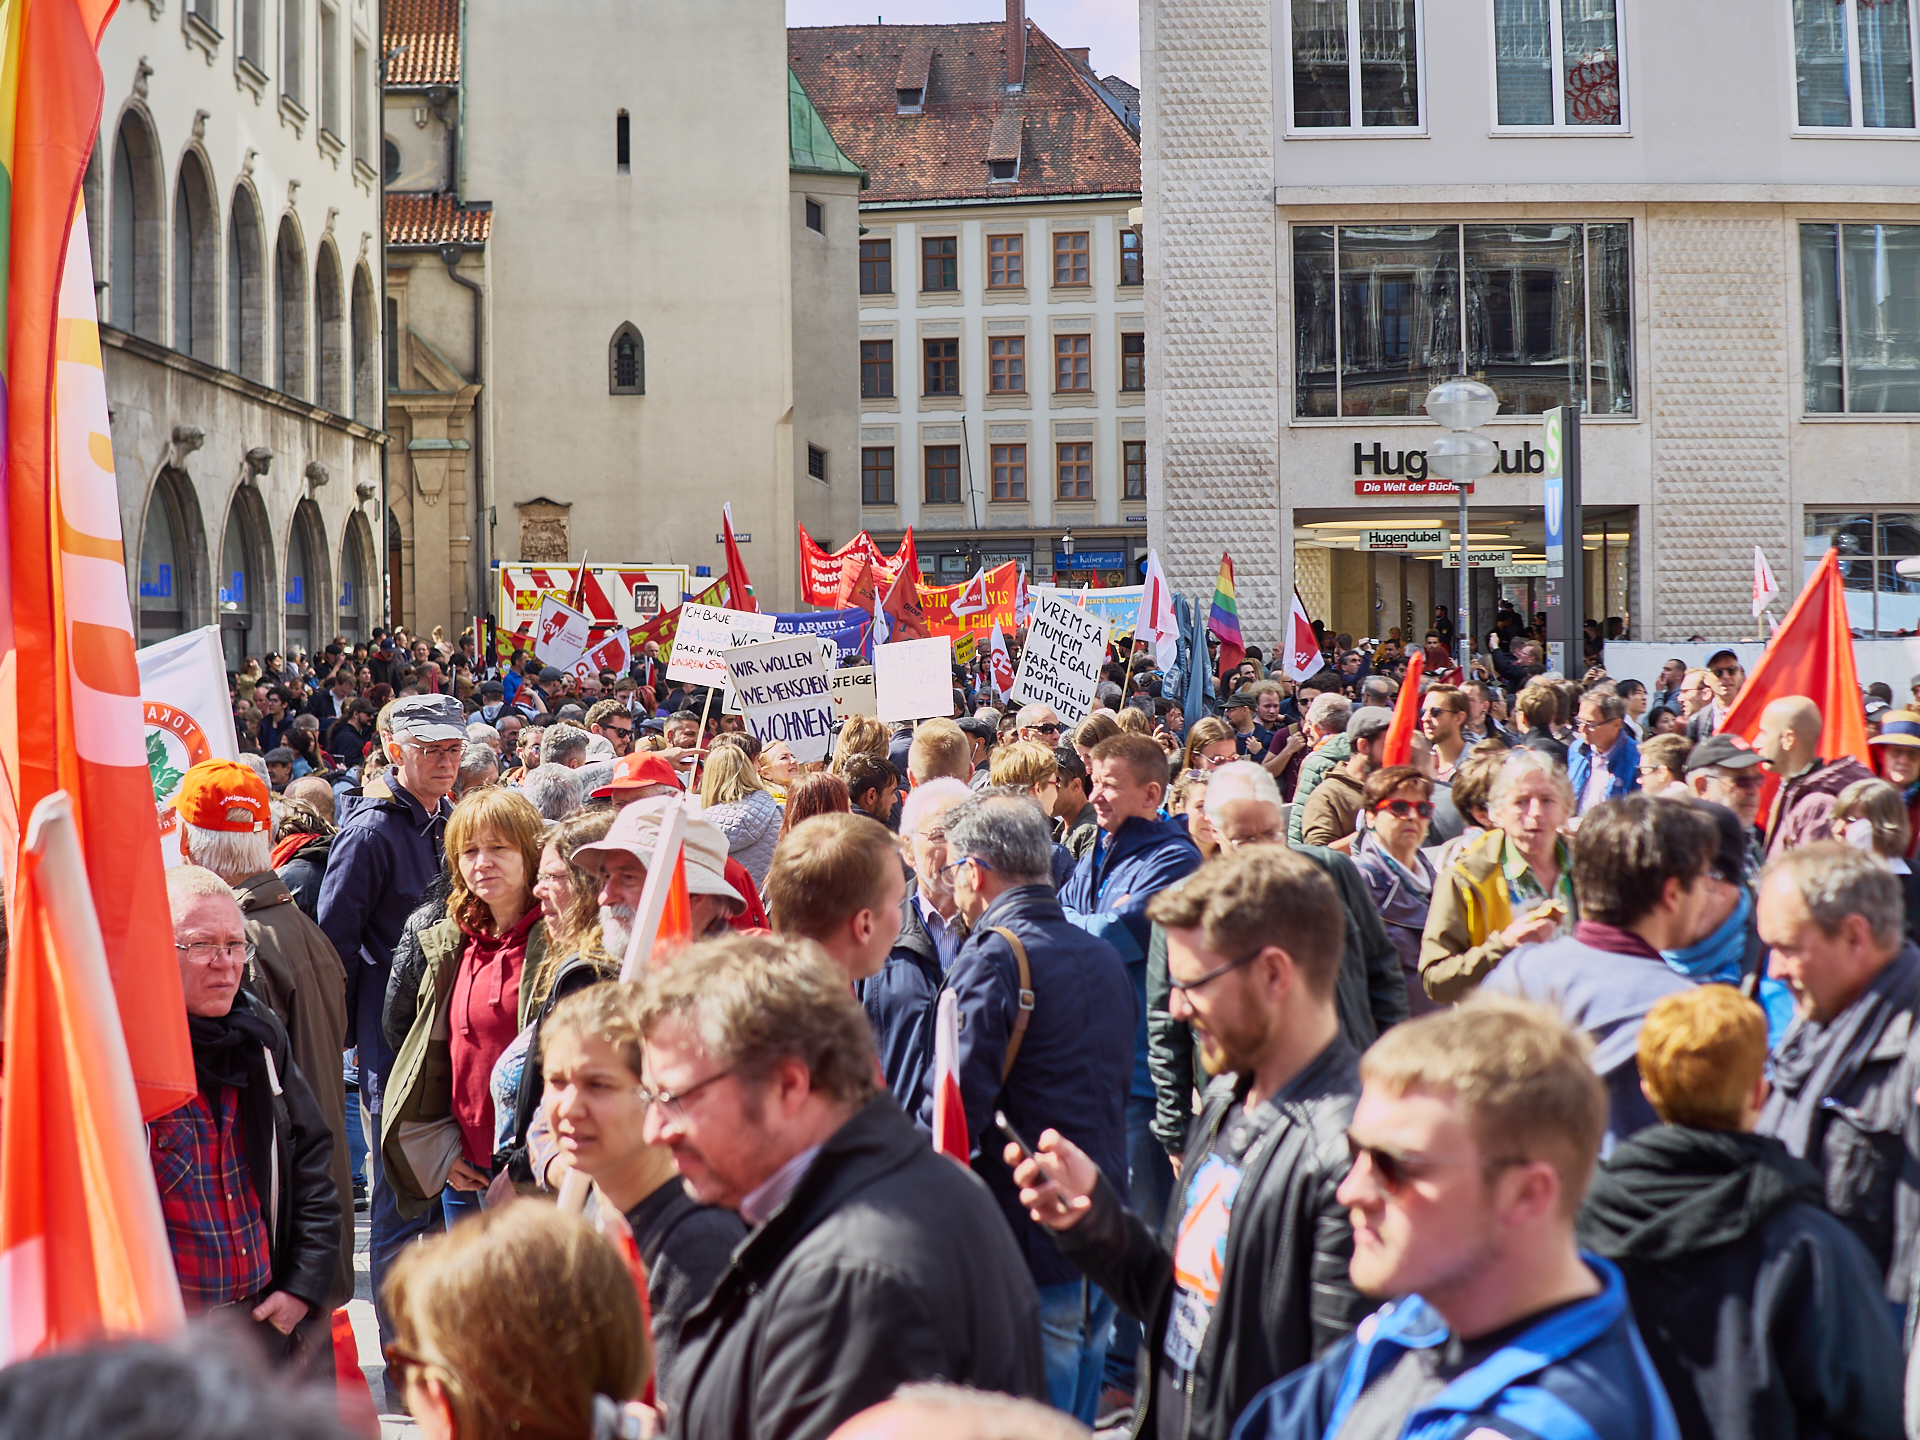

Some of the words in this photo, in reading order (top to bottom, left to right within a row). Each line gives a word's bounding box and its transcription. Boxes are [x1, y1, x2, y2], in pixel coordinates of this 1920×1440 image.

[1547, 420, 1560, 470] S
[1354, 441, 1544, 482] Hugub
[1363, 482, 1381, 492] Die
[1383, 481, 1406, 492] Welt
[1409, 481, 1426, 492] der
[1428, 481, 1462, 492] Büche
[1548, 486, 1560, 536] U
[718, 534, 750, 542] Peplatz
[1369, 531, 1441, 545] Hugendubel
[1450, 553, 1505, 562] Huendubel
[1498, 565, 1538, 574] BEYOND
[637, 595, 657, 607] 112
[684, 606, 701, 619] ICH
[702, 609, 732, 625] BAUE
[734, 614, 764, 632] EURE
[1042, 596, 1083, 633] VREM
[776, 622, 794, 632] ZU
[797, 620, 846, 633] ARMUT
[676, 643, 704, 655] DARF
[706, 648, 724, 657] NIC
[671, 657, 704, 669] UNSREN
[731, 660, 759, 678] WIR
[759, 651, 813, 673] WOLLEN
[1050, 643, 1098, 682] LEGAL!
[740, 685, 768, 706] WIE
[767, 675, 829, 702] MENSCHEN
[750, 706, 833, 743] WOHNEN
